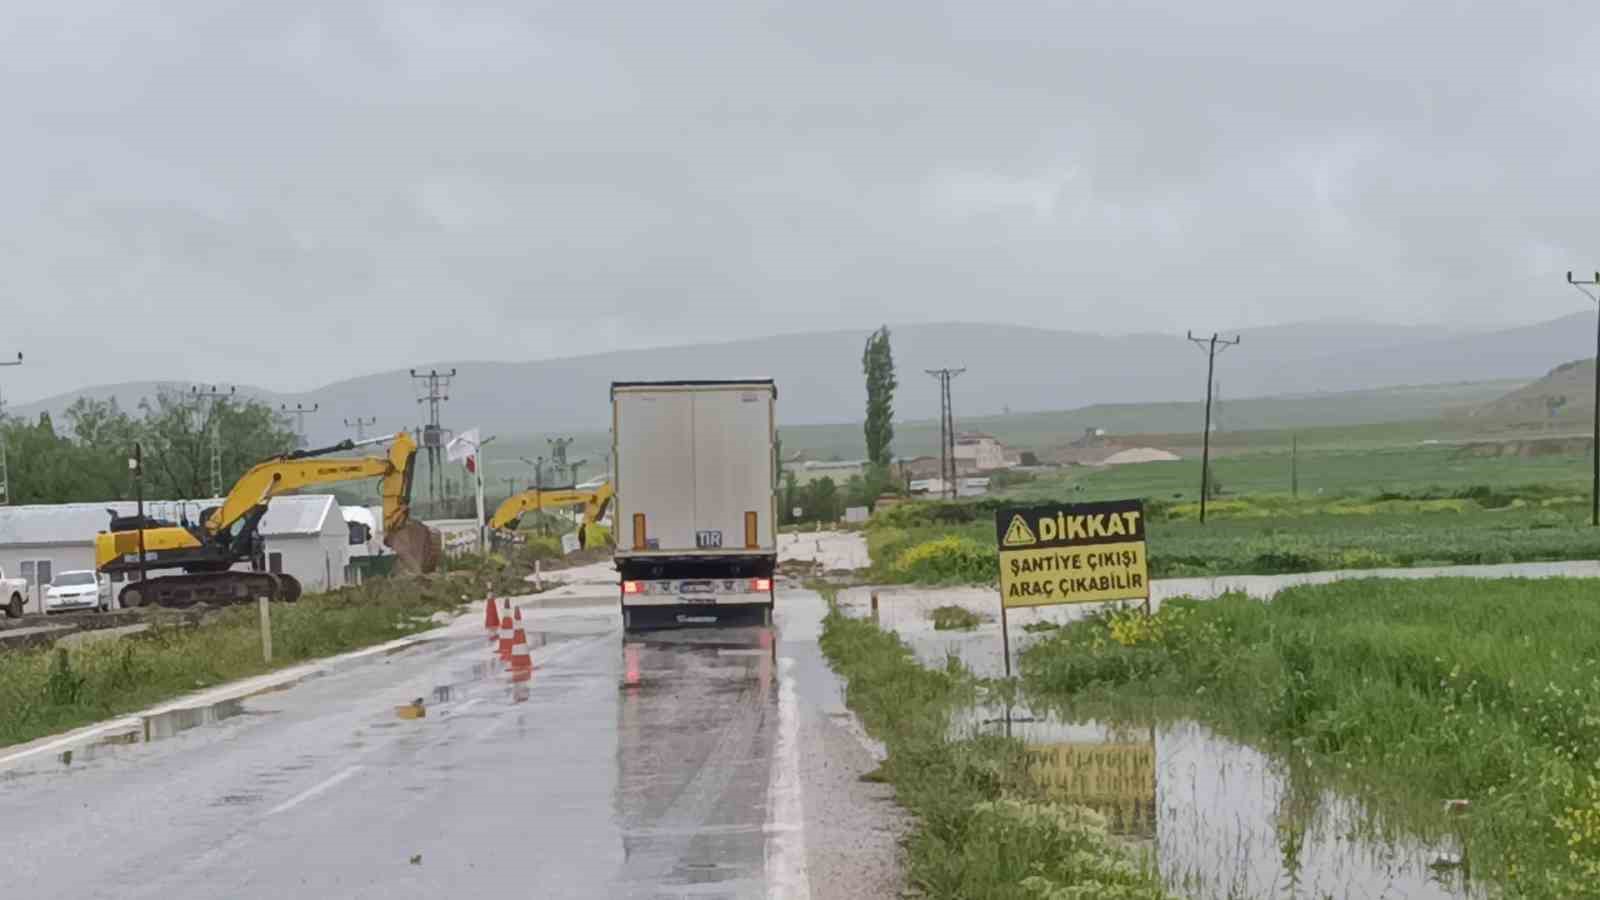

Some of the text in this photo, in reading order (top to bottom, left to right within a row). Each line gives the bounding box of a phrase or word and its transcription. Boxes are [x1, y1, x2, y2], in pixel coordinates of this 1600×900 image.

[698, 532, 721, 546] TIR
[1038, 511, 1140, 542] DİKKAT
[1010, 551, 1137, 576] ŞANTİYE ÇIKIŞI
[1009, 571, 1142, 598] ARAÇ ÇIKABİLİR
